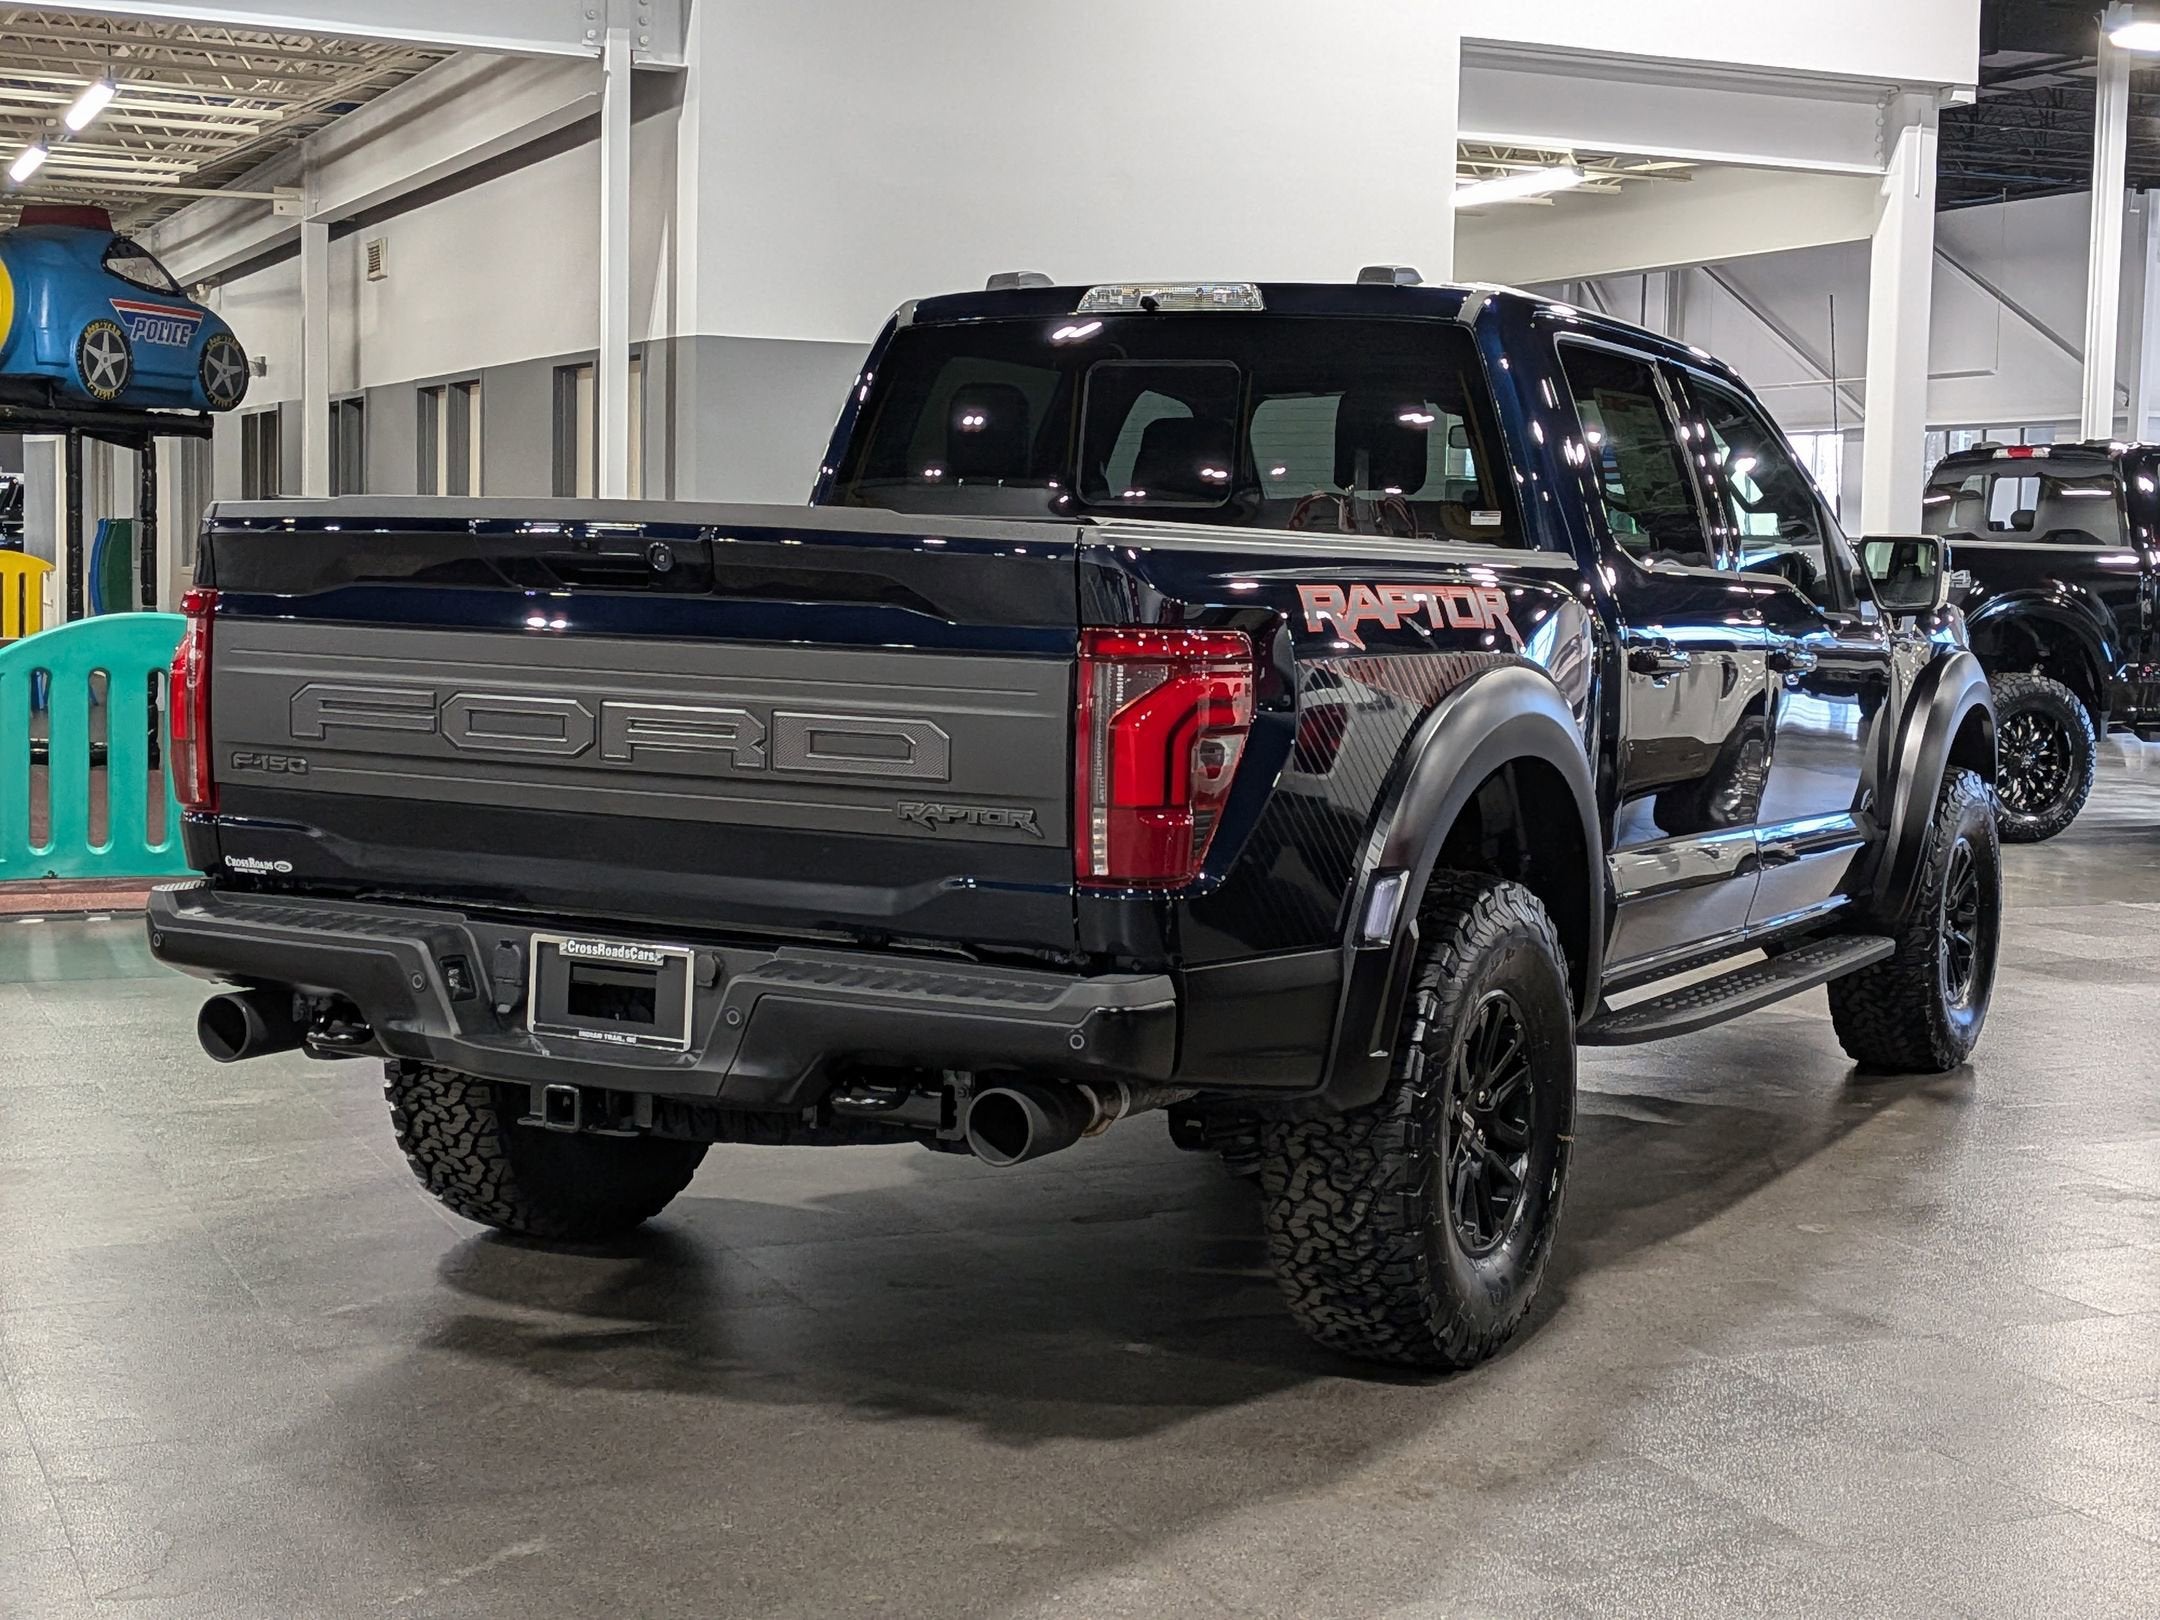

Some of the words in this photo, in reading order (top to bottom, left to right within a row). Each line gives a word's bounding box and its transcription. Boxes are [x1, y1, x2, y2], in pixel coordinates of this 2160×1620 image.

[132, 317, 191, 347] POLICE
[1296, 584, 1526, 651] RAPTOR
[290, 683, 951, 782] FORD
[231, 752, 308, 775] F-150
[897, 800, 1045, 839] RAPTOR
